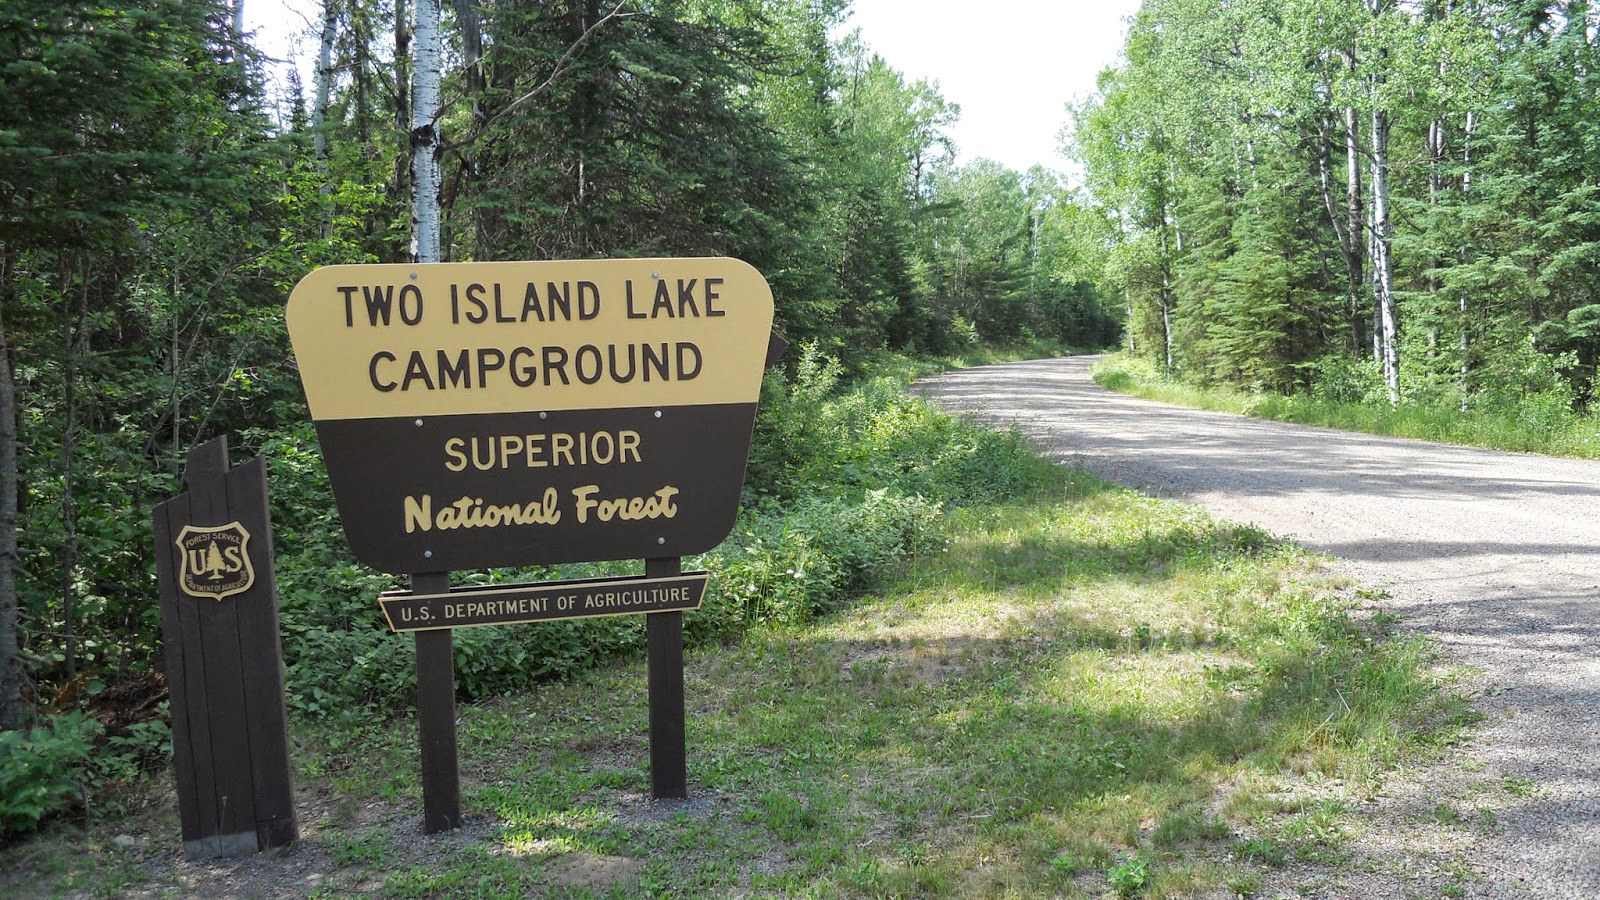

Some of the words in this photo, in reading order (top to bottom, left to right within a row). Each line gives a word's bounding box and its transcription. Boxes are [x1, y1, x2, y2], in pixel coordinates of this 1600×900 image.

[337, 284, 424, 327] TWO
[451, 281, 601, 324] ISLAND
[626, 277, 726, 319] LAKE
[369, 342, 703, 392] CAMPGROUND
[445, 430, 642, 472] SUPERIOR
[404, 487, 562, 534] National
[572, 484, 680, 524] Forest
[186, 533, 211, 548] FOREST
[212, 532, 240, 544] SERVICE
[401, 606, 436, 622] U.S.
[445, 598, 549, 619] DEPARTMENT
[557, 596, 578, 611] OF
[585, 587, 691, 607] AGRICULTURE
